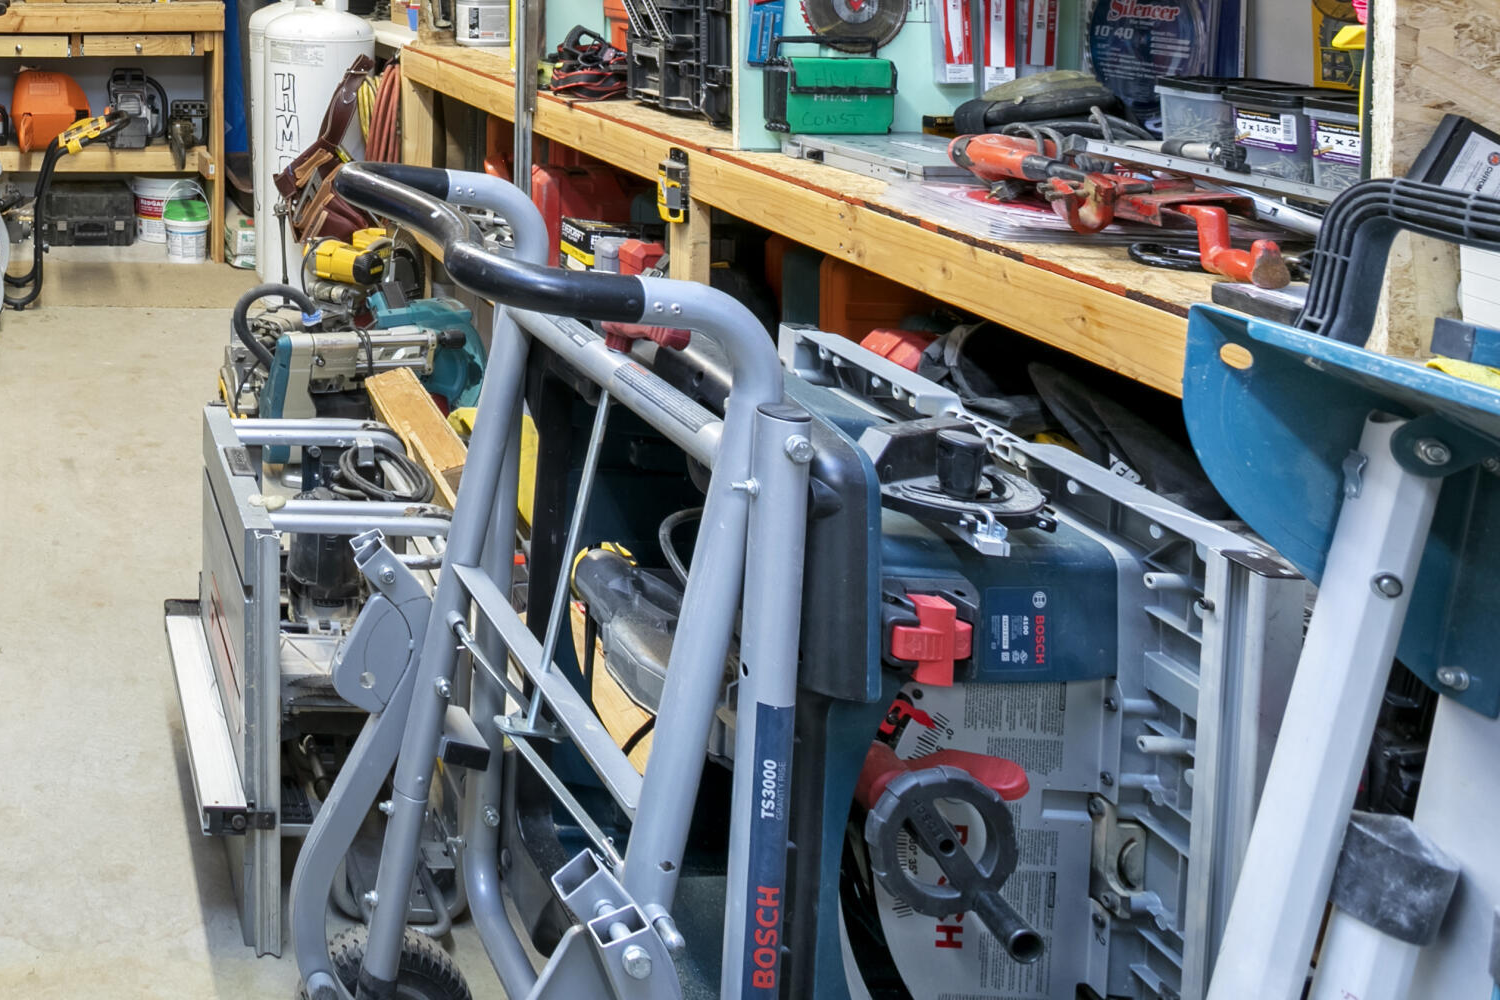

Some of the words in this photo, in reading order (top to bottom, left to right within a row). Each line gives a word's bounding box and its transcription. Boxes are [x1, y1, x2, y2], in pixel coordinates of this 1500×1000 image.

[1240, 121, 1248, 130] 7
[1322, 134, 1331, 145] 7
[1035, 615, 1044, 664] BOSCH
[760, 758, 777, 820] TS3000
[777, 762, 787, 782] RISE
[776, 784, 786, 821] GRAVITY
[751, 885, 780, 990] BOSCH
